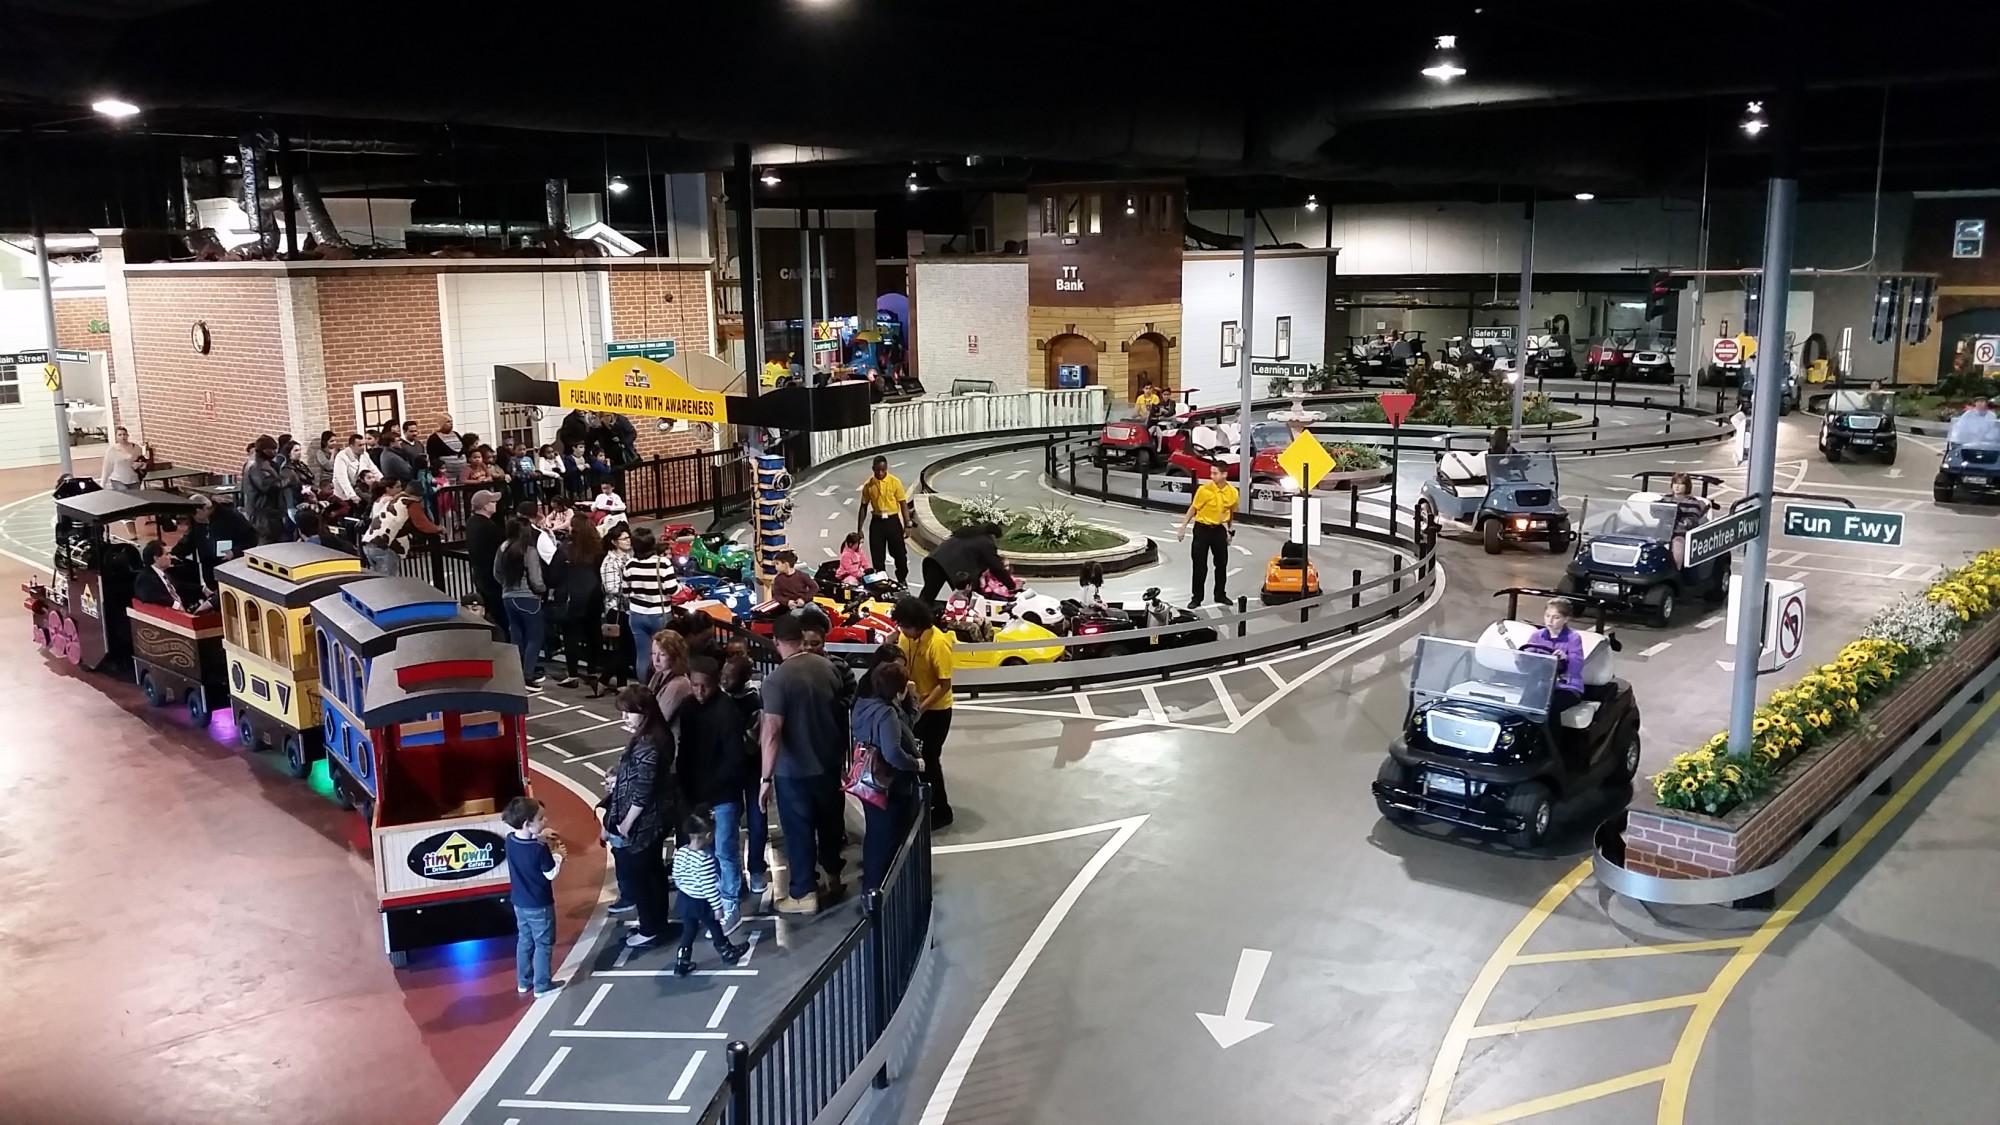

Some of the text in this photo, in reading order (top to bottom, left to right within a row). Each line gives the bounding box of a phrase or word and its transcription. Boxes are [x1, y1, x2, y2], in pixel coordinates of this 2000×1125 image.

[1062, 266, 1078, 278] TT
[1056, 279, 1084, 291] Bank
[1475, 330, 1498, 338] Safety
[0, 354, 46, 364] ain Street
[1253, 364, 1305, 376] Learning Ln
[570, 389, 714, 416] FUELING YOUR KIDS WITH AWARENESS
[1788, 512, 1831, 533] Fun
[1690, 517, 1760, 559] Peachtree Pkwy
